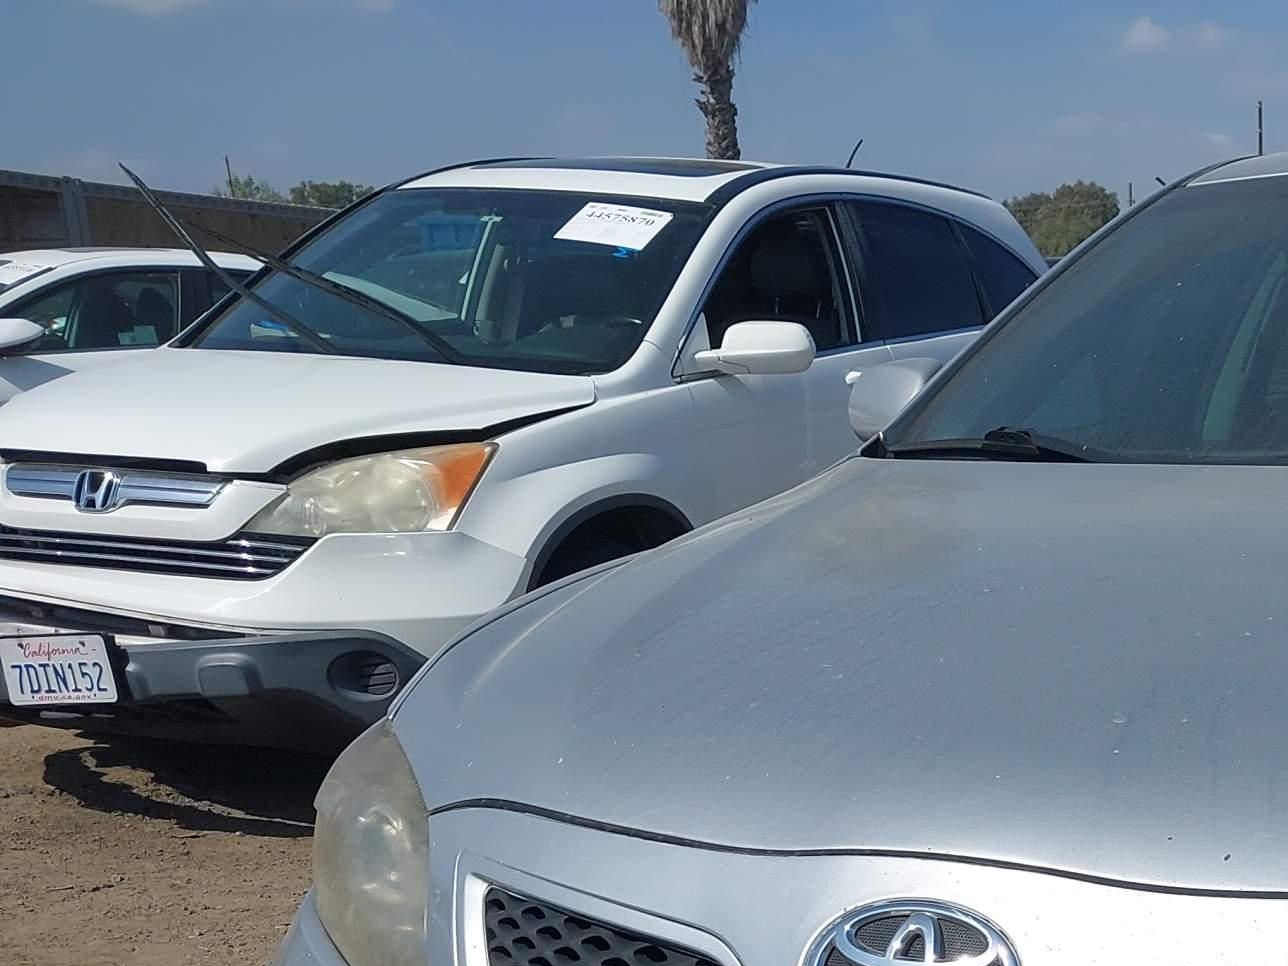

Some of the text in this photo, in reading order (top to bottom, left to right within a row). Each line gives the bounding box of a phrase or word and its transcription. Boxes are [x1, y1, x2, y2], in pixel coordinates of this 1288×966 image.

[586, 211, 655, 226] 44575870
[23, 642, 88, 661] California
[10, 662, 107, 694] 7DIN152
